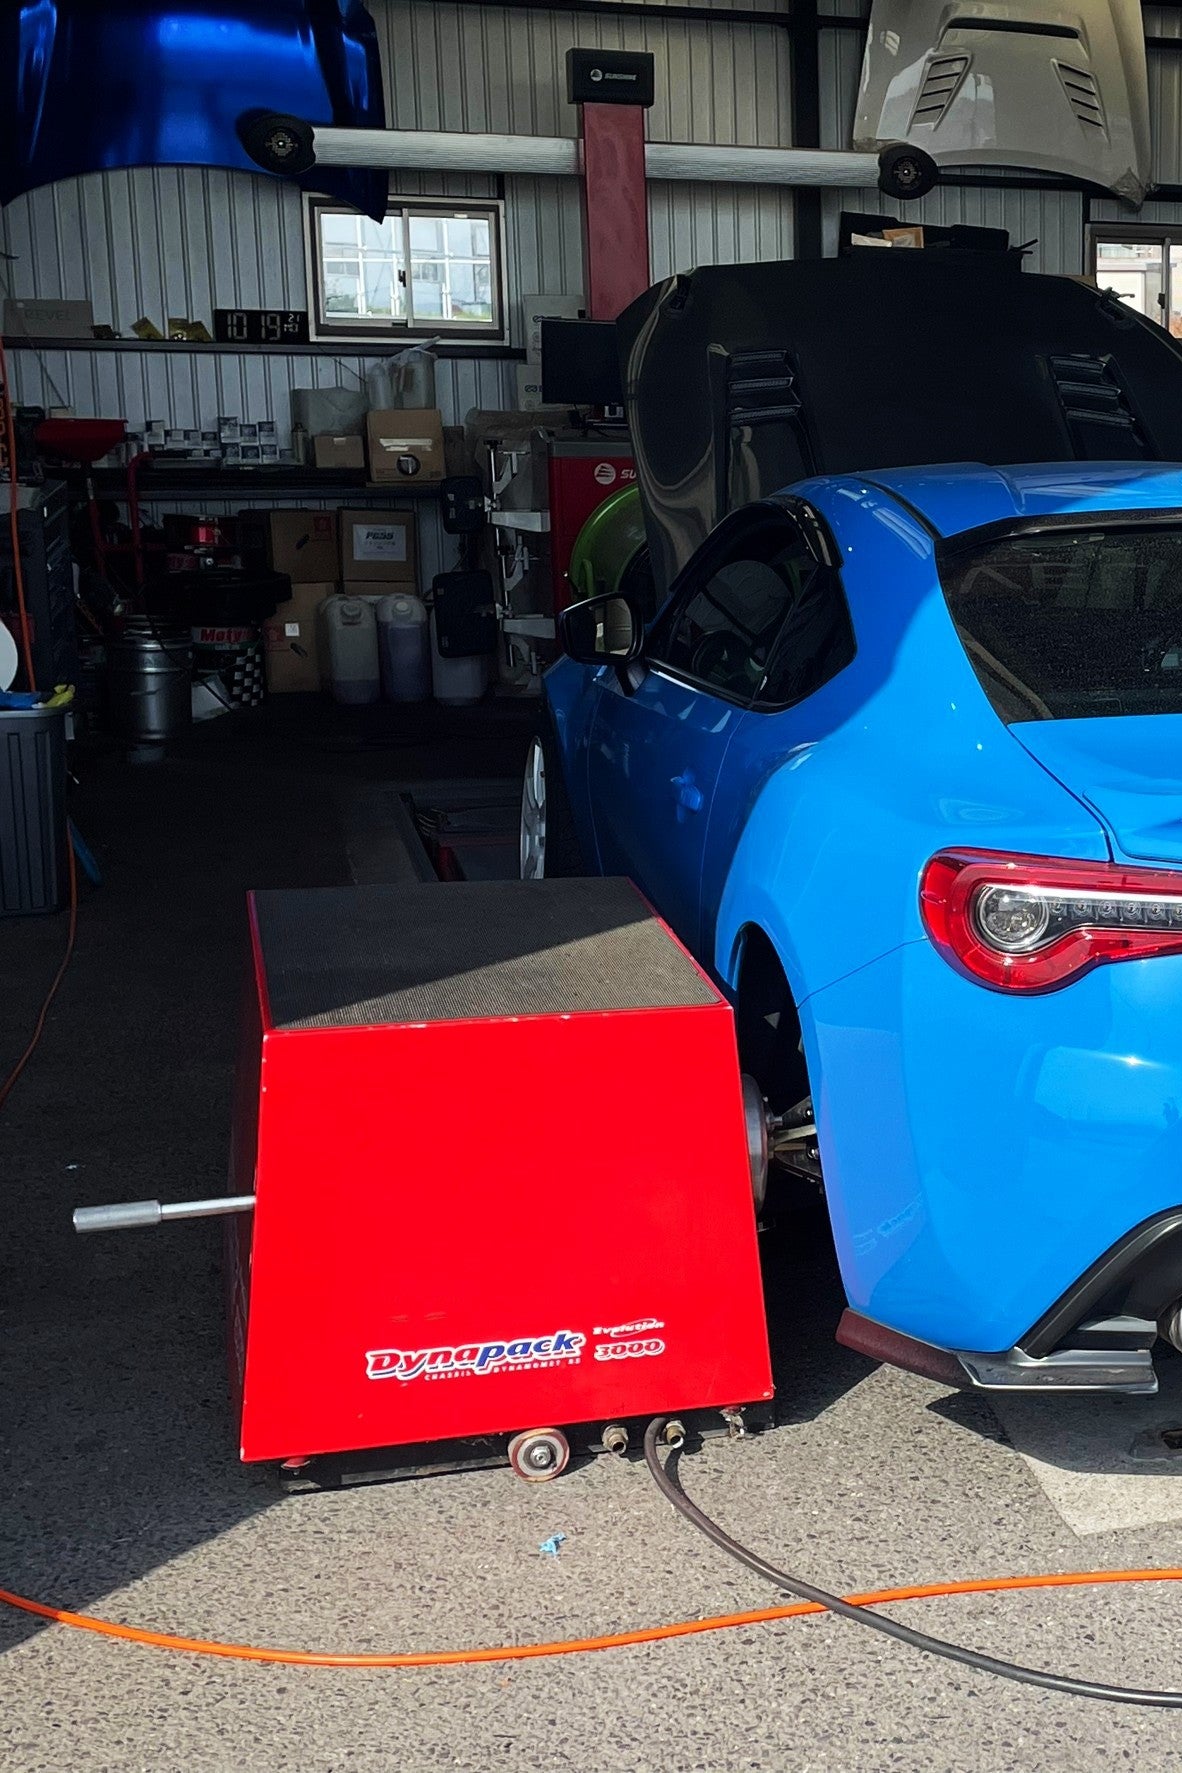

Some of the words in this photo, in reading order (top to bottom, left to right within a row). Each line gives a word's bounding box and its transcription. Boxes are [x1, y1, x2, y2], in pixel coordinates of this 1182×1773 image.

[366, 1329, 587, 1380] Dynapack
[593, 1338, 666, 1361] 3000
[424, 1370, 472, 1381] CHASSIS
